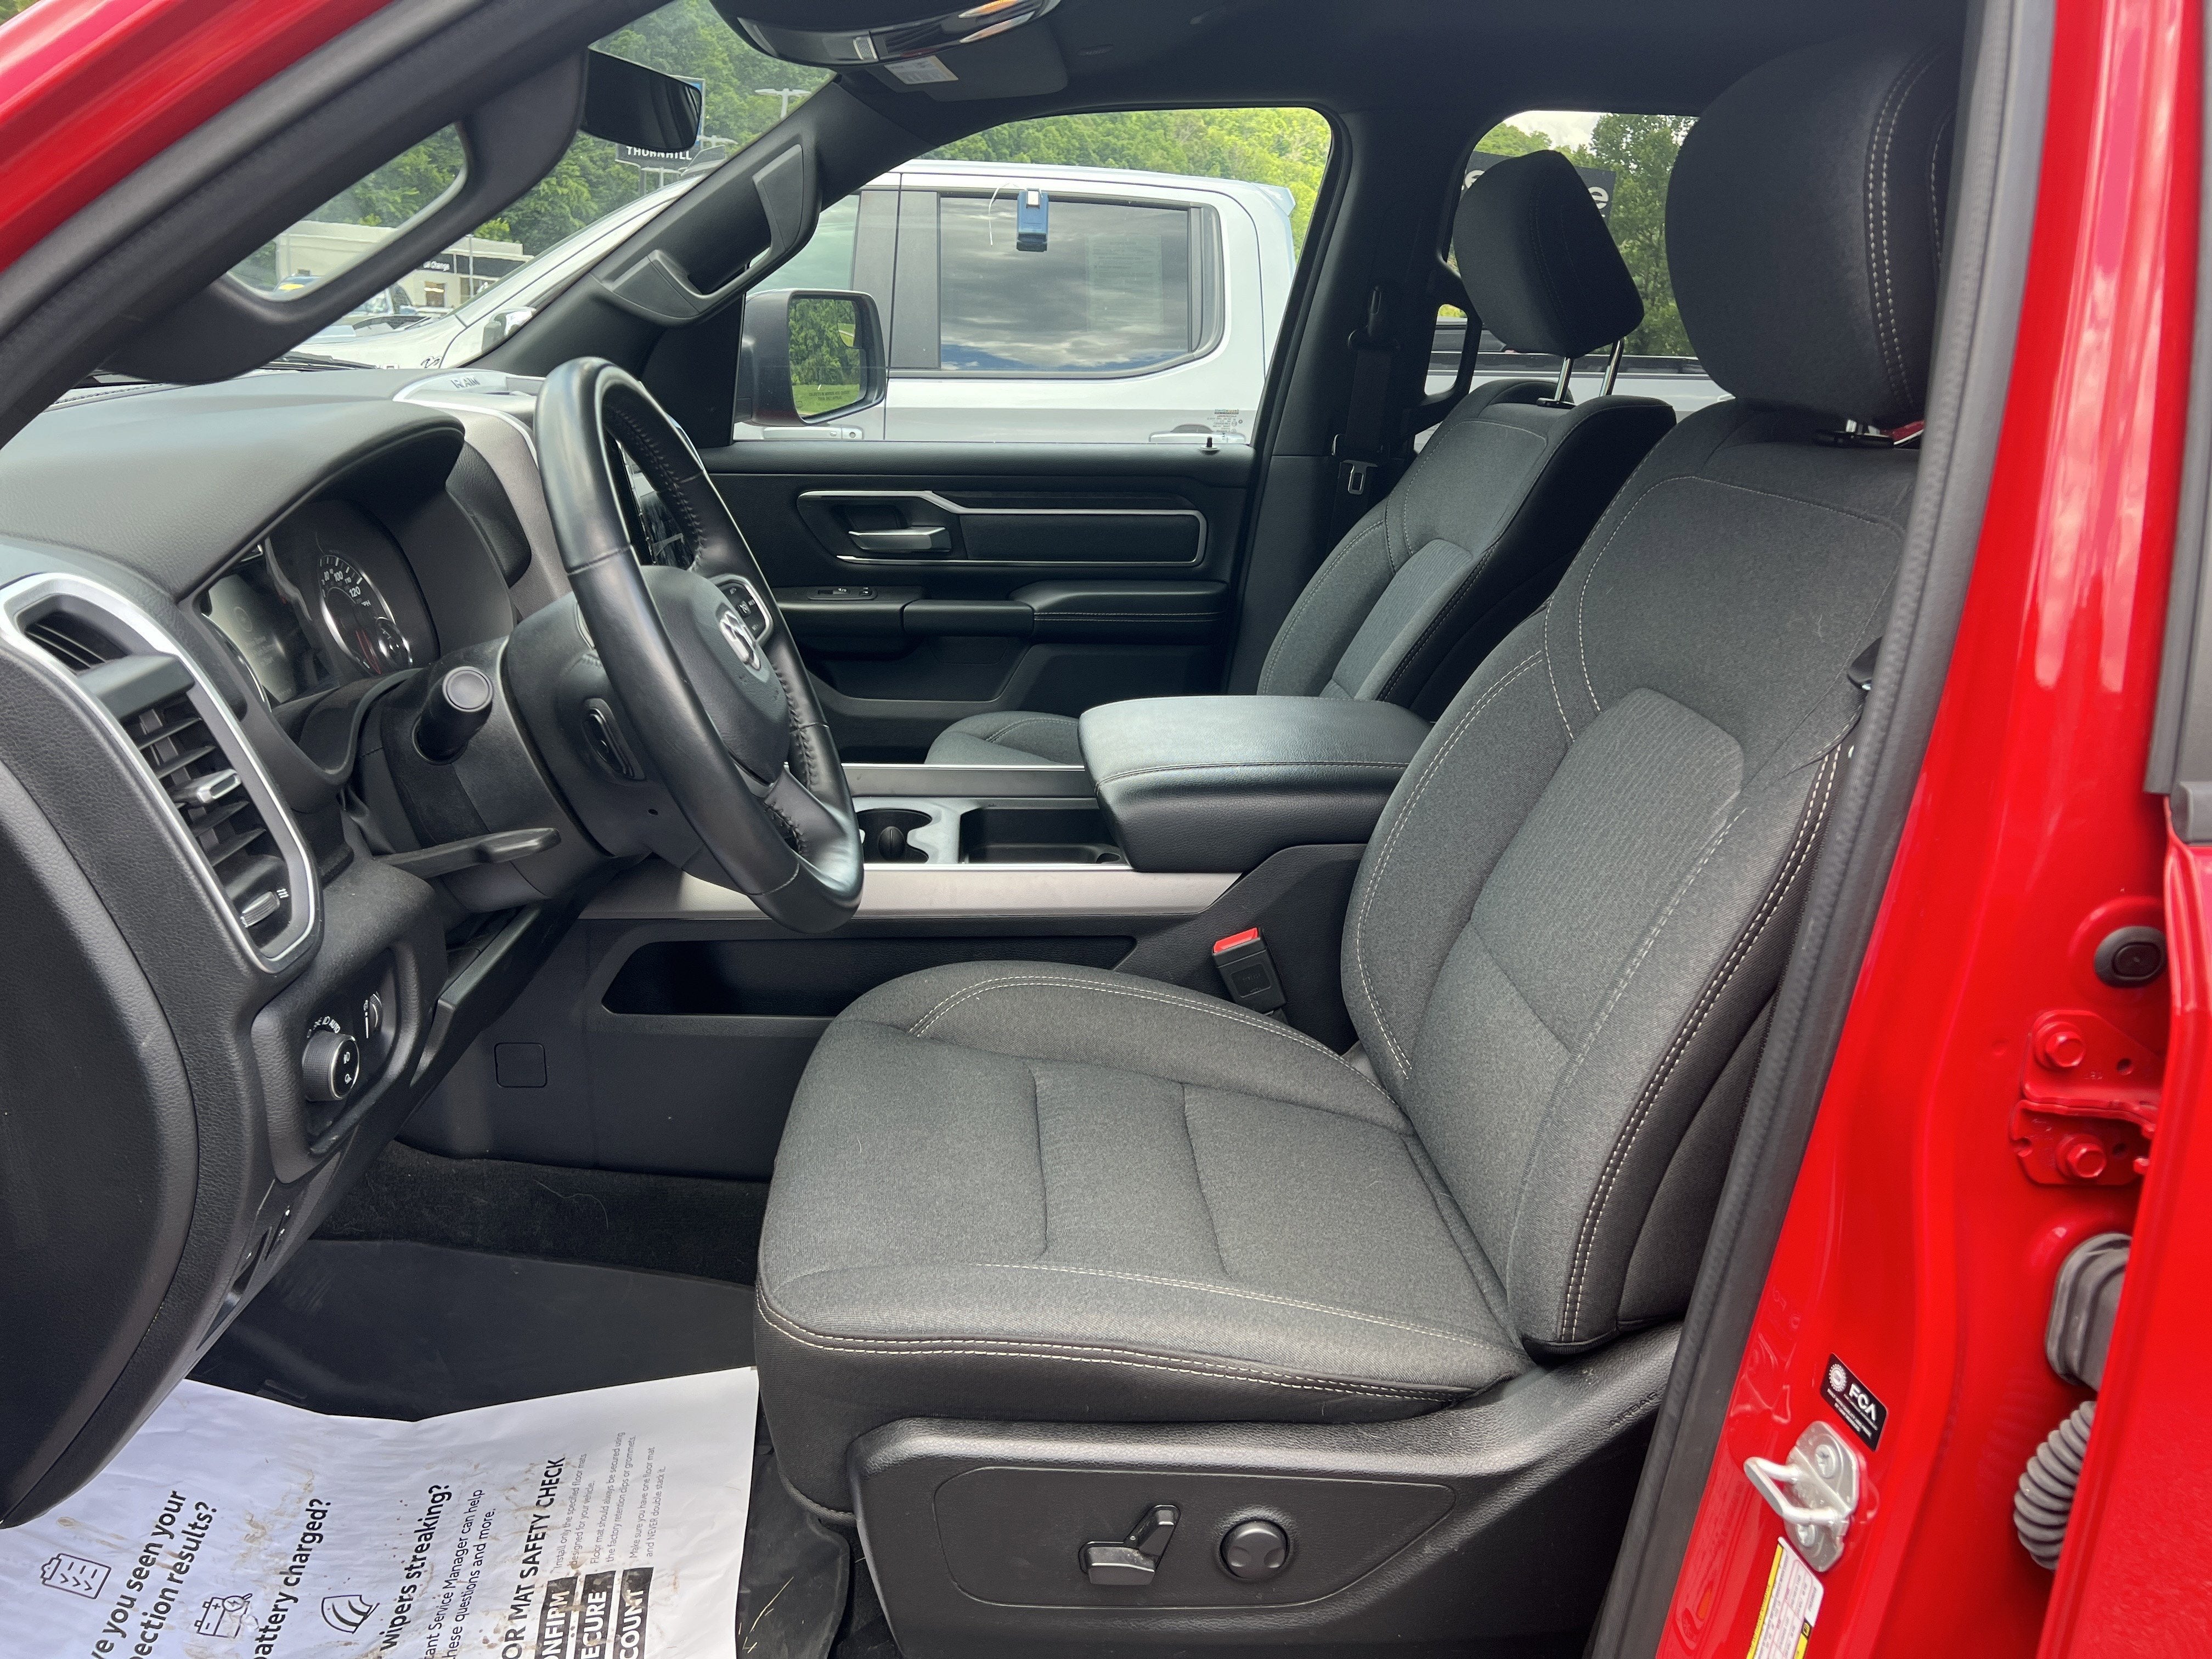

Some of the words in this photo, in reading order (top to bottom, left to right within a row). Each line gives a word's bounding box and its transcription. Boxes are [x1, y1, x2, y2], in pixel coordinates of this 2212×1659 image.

[450, 376, 480, 389] RAM
[334, 571, 343, 582] 100
[349, 586, 361, 598] 120
[329, 1019, 341, 1034] AUTO
[1849, 1383, 1876, 1421] FCA
[615, 1431, 626, 1447] using
[578, 1453, 587, 1469] mats
[610, 1448, 620, 1474] secured
[642, 1462, 652, 1477] floor
[535, 1457, 566, 1508] CHECK
[572, 1471, 583, 1487] floor
[606, 1474, 615, 1484] be
[642, 1477, 651, 1492] one
[464, 1489, 485, 1514] help
[614, 1494, 627, 1522] retention
[640, 1492, 648, 1509] have
[650, 1491, 662, 1516] double
[563, 1516, 572, 1528] the
[580, 1504, 589, 1520] your
[598, 1506, 610, 1528] should
[637, 1509, 647, 1522] you
[462, 1515, 475, 1534] can
[478, 1509, 496, 1539] more.
[576, 1520, 585, 1531] for
[635, 1522, 643, 1538] sure
[647, 1517, 658, 1541] NEVER
[279, 1498, 331, 1587] charged?
[520, 1514, 550, 1579] SAFETY
[561, 1529, 571, 1543] only
[596, 1529, 604, 1543] mat
[607, 1523, 622, 1548] factory
[472, 1543, 487, 1566] and
[554, 1543, 566, 1568] Install
[571, 1531, 583, 1565] designed
[590, 1544, 601, 1564] Floor
[605, 1548, 615, 1563] the
[629, 1539, 640, 1559] Make
[646, 1542, 655, 1558] and
[102, 1594, 137, 1639] you
[126, 1543, 163, 1592] seen
[151, 1491, 187, 1539] your
[379, 1584, 417, 1651] wipers
[404, 1485, 452, 1580] streaking?
[442, 1538, 469, 1589] Manager
[129, 1588, 179, 1659] ection
[167, 1502, 217, 1584] results?
[455, 1570, 480, 1622] questions
[508, 1584, 535, 1621] MAT
[428, 1592, 453, 1629] Service
[541, 1590, 570, 1659] NFIRM
[581, 1592, 608, 1659] ECURE
[441, 1626, 463, 1659] hese
